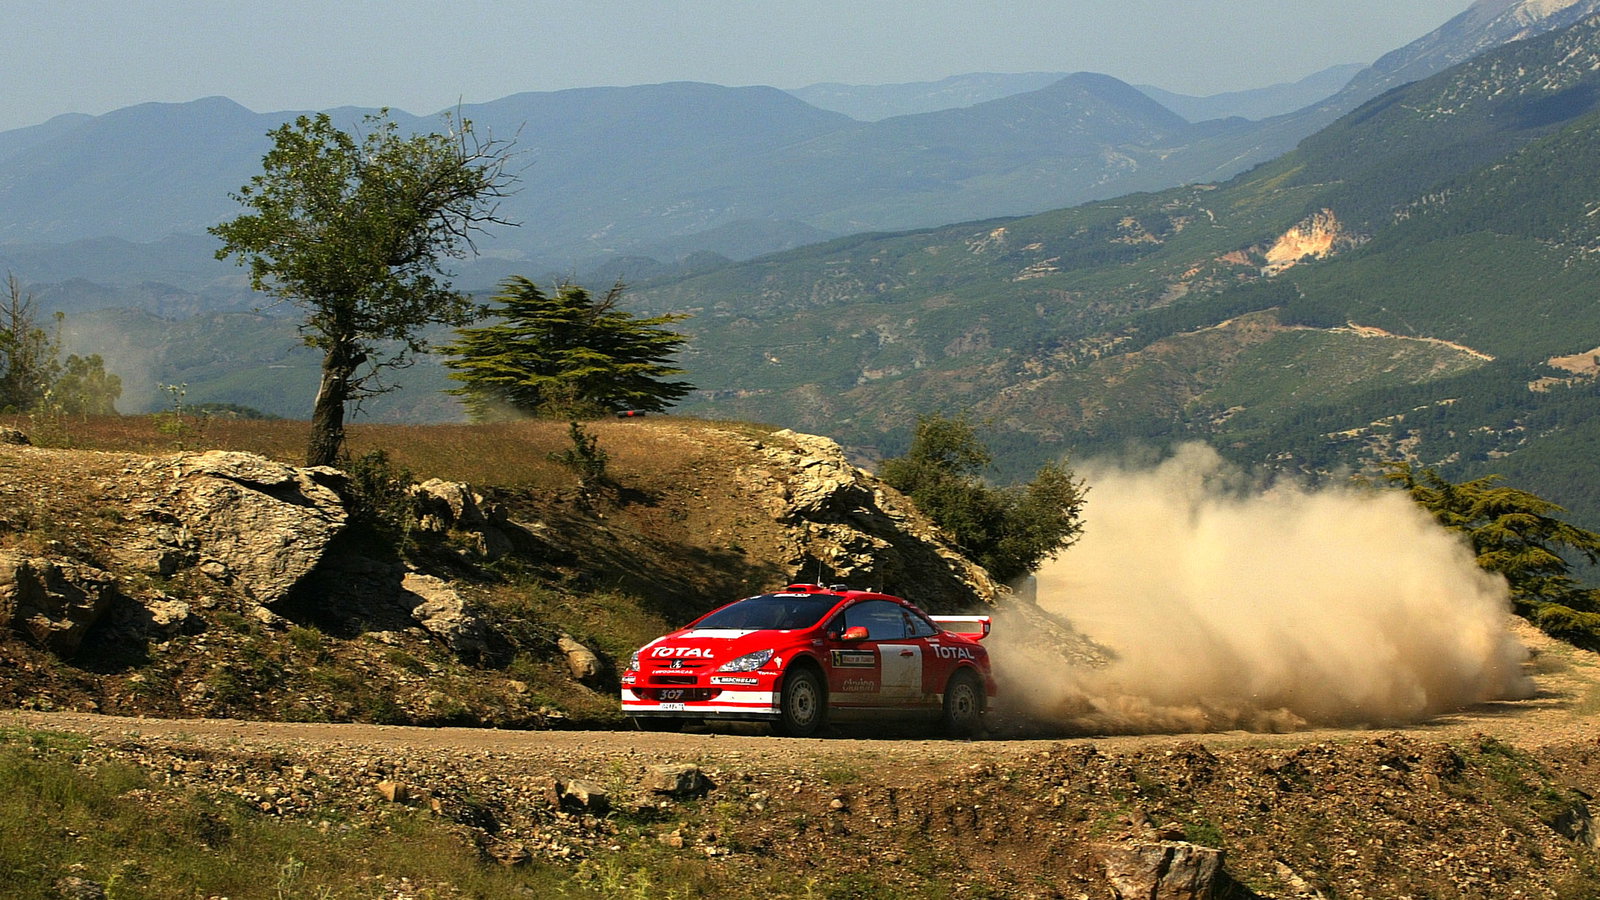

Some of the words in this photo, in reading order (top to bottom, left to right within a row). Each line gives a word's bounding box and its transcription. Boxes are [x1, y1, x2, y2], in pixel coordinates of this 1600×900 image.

[651, 647, 714, 658] TOTAL
[929, 643, 976, 659] TOTAL
[835, 651, 841, 666] 5
[659, 689, 684, 701] 307
